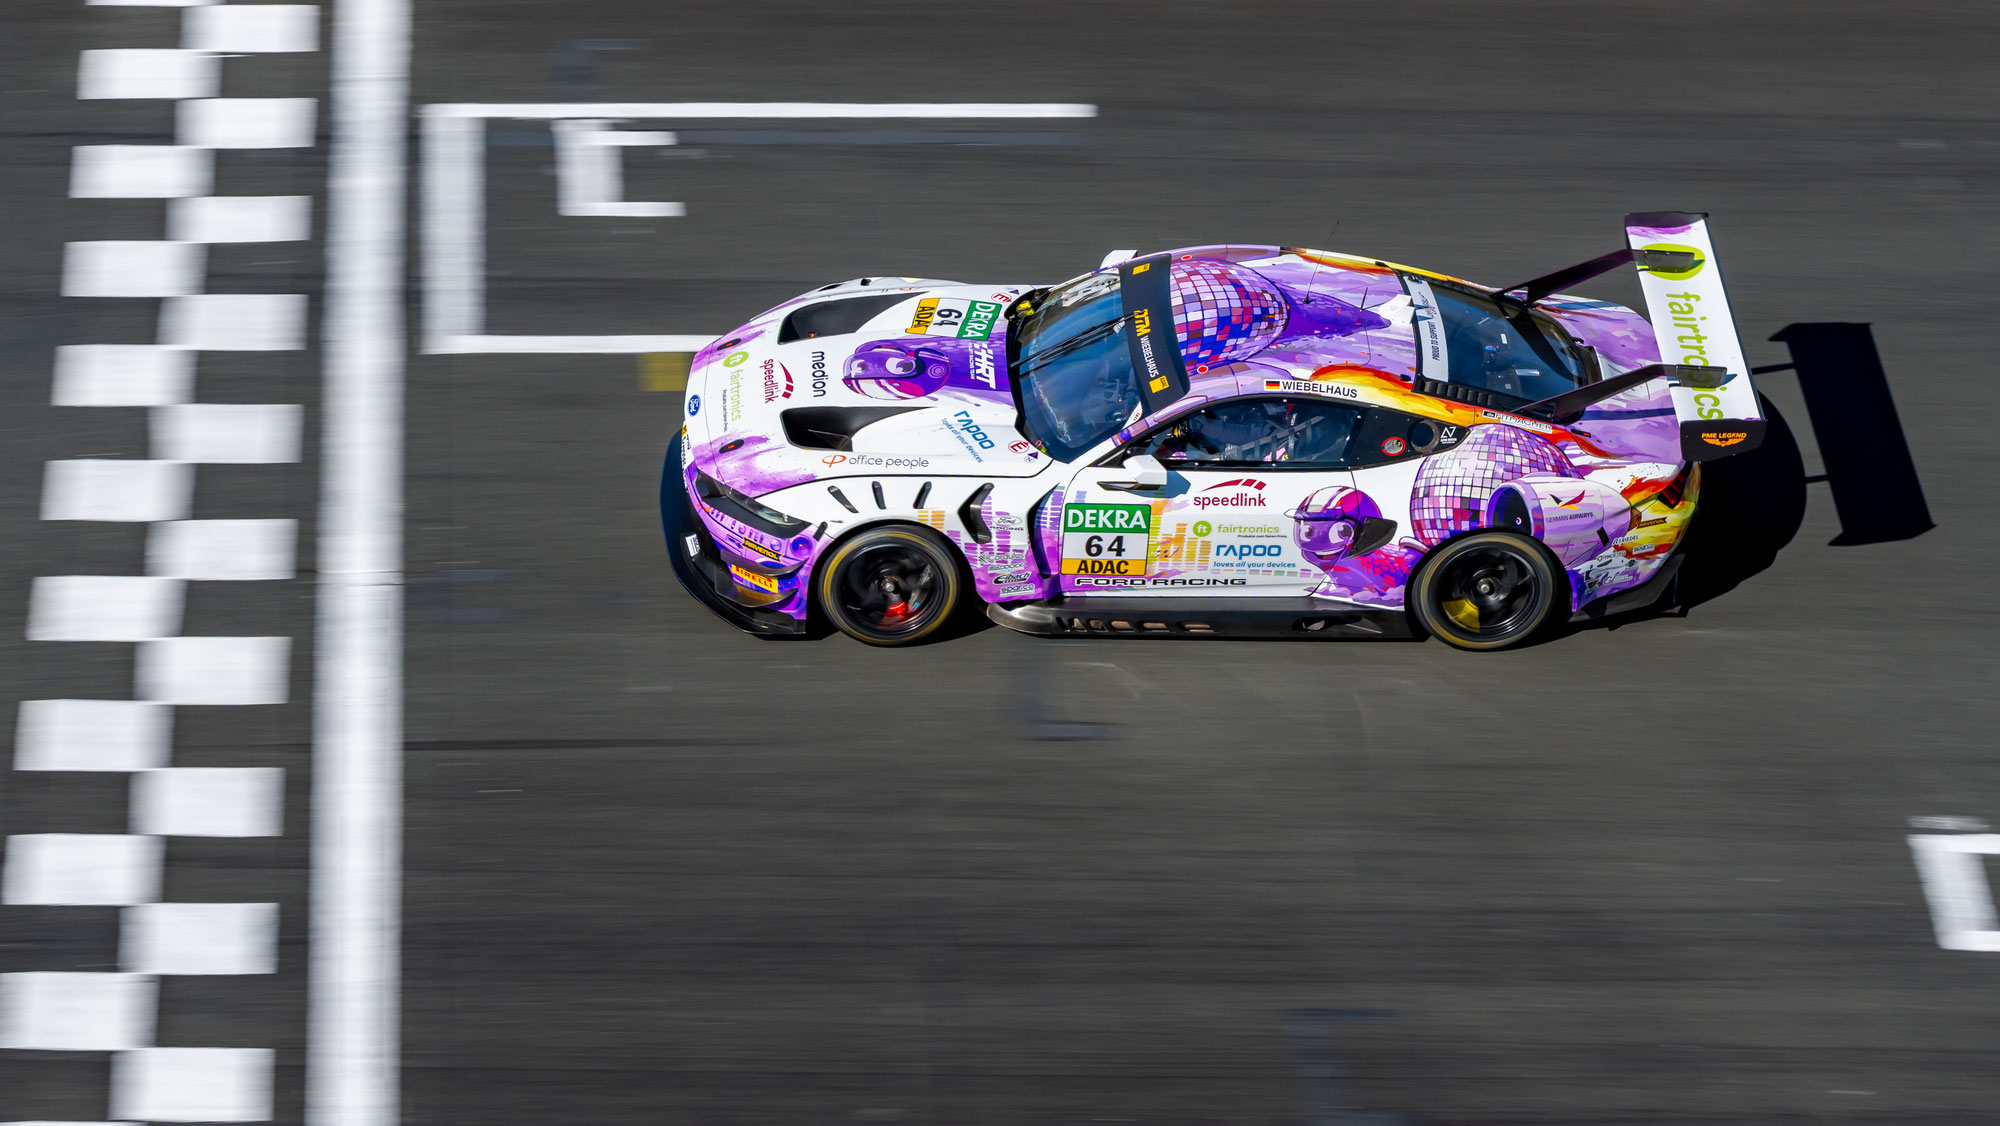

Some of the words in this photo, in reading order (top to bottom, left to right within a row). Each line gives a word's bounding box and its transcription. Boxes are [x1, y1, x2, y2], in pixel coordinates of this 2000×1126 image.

[913, 306, 935, 329] ADA
[933, 308, 962, 326] 64
[962, 302, 996, 338] DEKRA
[1134, 308, 1151, 336] DTM
[1428, 321, 1438, 340] SUPPORT
[1140, 335, 1160, 378] WIEBELHAUS
[1432, 345, 1440, 360] PROUD
[1666, 292, 1728, 420] fairtroics
[760, 358, 779, 404] speedlink
[812, 351, 828, 398] medion
[730, 369, 744, 422] fairtronics
[1282, 381, 1358, 398] WIEBELHAUS
[849, 454, 883, 465] office
[886, 458, 929, 469] people
[1193, 493, 1266, 510] speedlink
[1068, 509, 1146, 528] DEKRA
[1218, 524, 1279, 534] fairtronics
[745, 540, 778, 560] RAVENOL
[1085, 535, 1126, 557] 64
[1216, 545, 1282, 560] rapoo
[1077, 560, 1129, 574] ADAC
[1152, 578, 1246, 586] RACING
